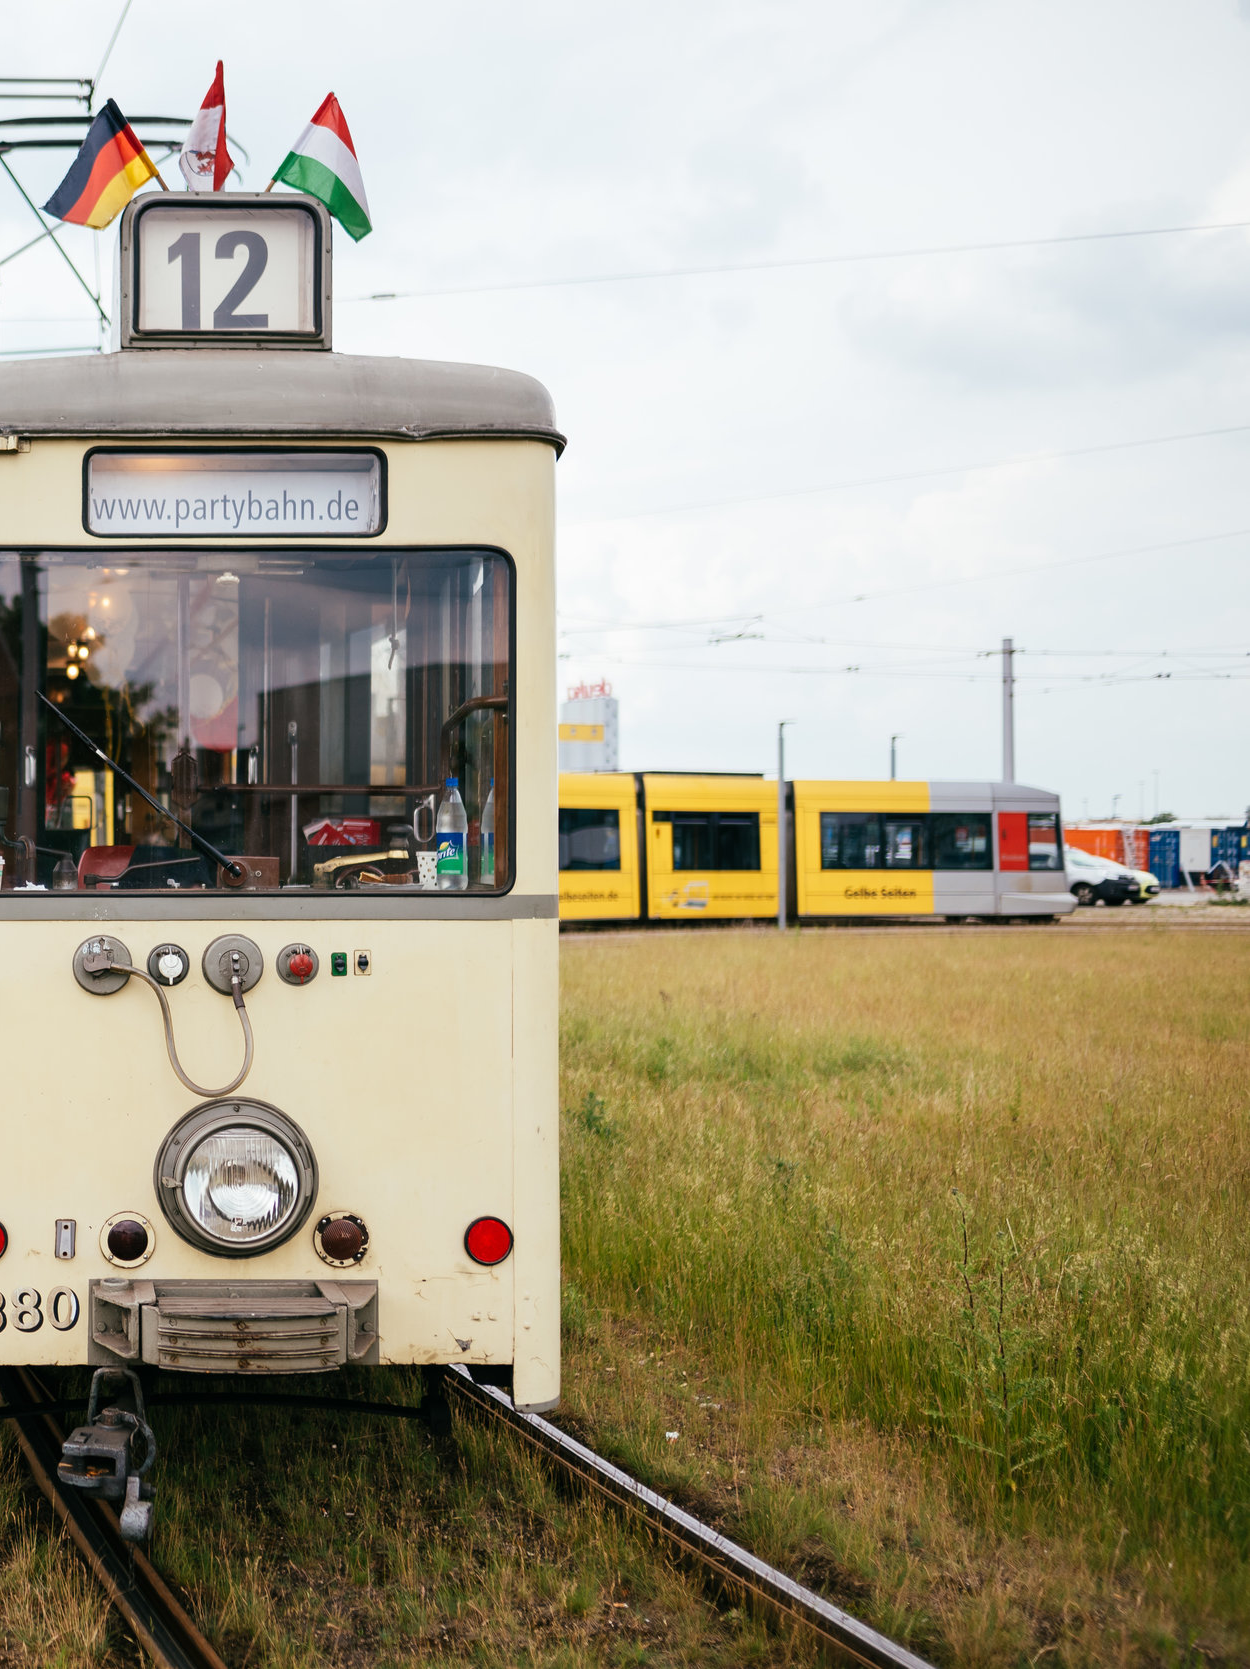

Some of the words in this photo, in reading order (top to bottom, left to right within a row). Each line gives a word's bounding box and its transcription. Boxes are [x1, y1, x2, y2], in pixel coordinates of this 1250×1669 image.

[167, 229, 269, 330] 12
[92, 489, 359, 529] www.partybahn.de
[844, 885, 878, 899] Gelbe
[881, 885, 917, 898] Seiten
